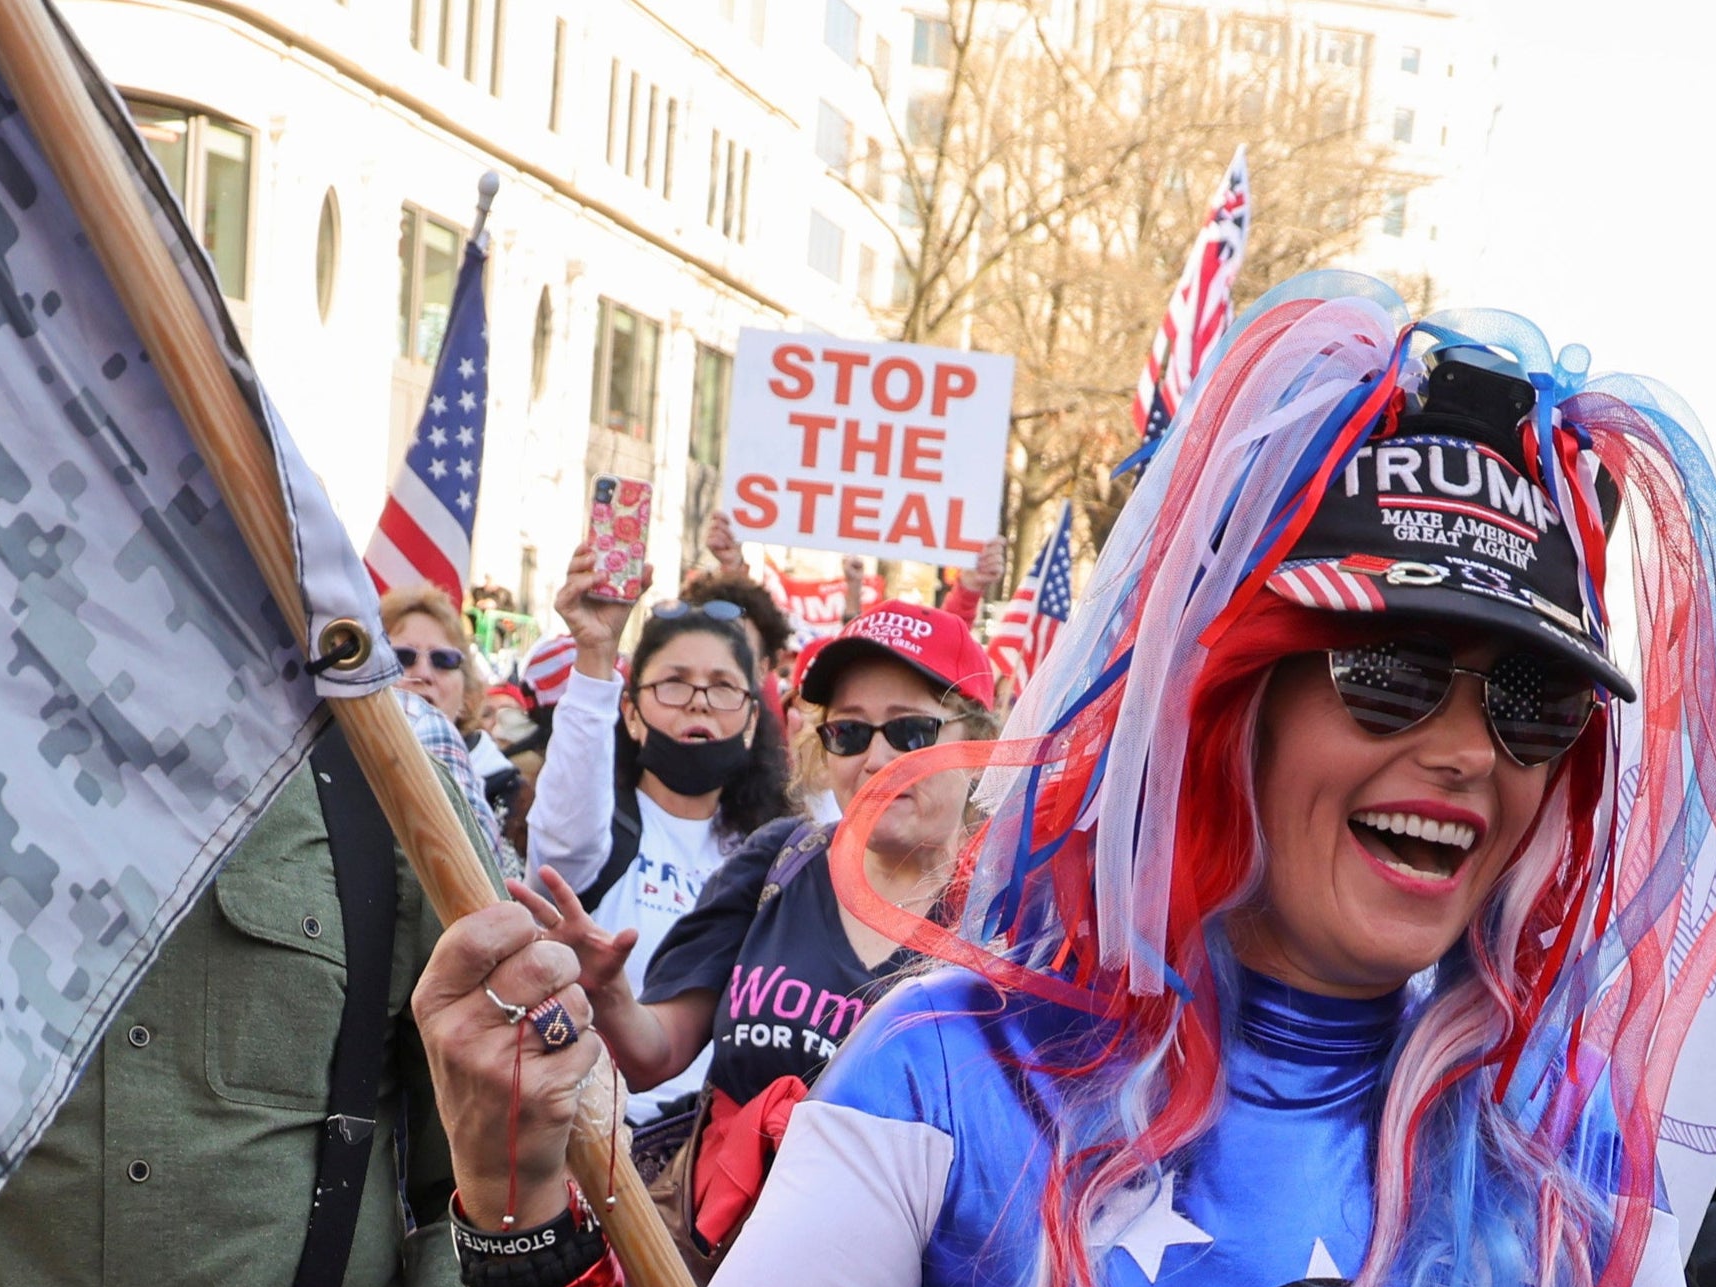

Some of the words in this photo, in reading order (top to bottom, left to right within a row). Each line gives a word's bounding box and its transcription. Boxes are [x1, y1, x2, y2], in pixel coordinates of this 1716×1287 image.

[768, 343, 978, 417] STOP
[788, 412, 947, 483] THE
[732, 473, 985, 553] STEAL
[1342, 445, 1561, 534] TRUMP
[1380, 508, 1444, 530] MAKE
[1452, 519, 1538, 560] AMERICA
[1392, 524, 1463, 547] GREAT
[1472, 537, 1531, 571] AGAIN
[891, 638, 924, 655] GREAT
[728, 963, 872, 1037] Wom
